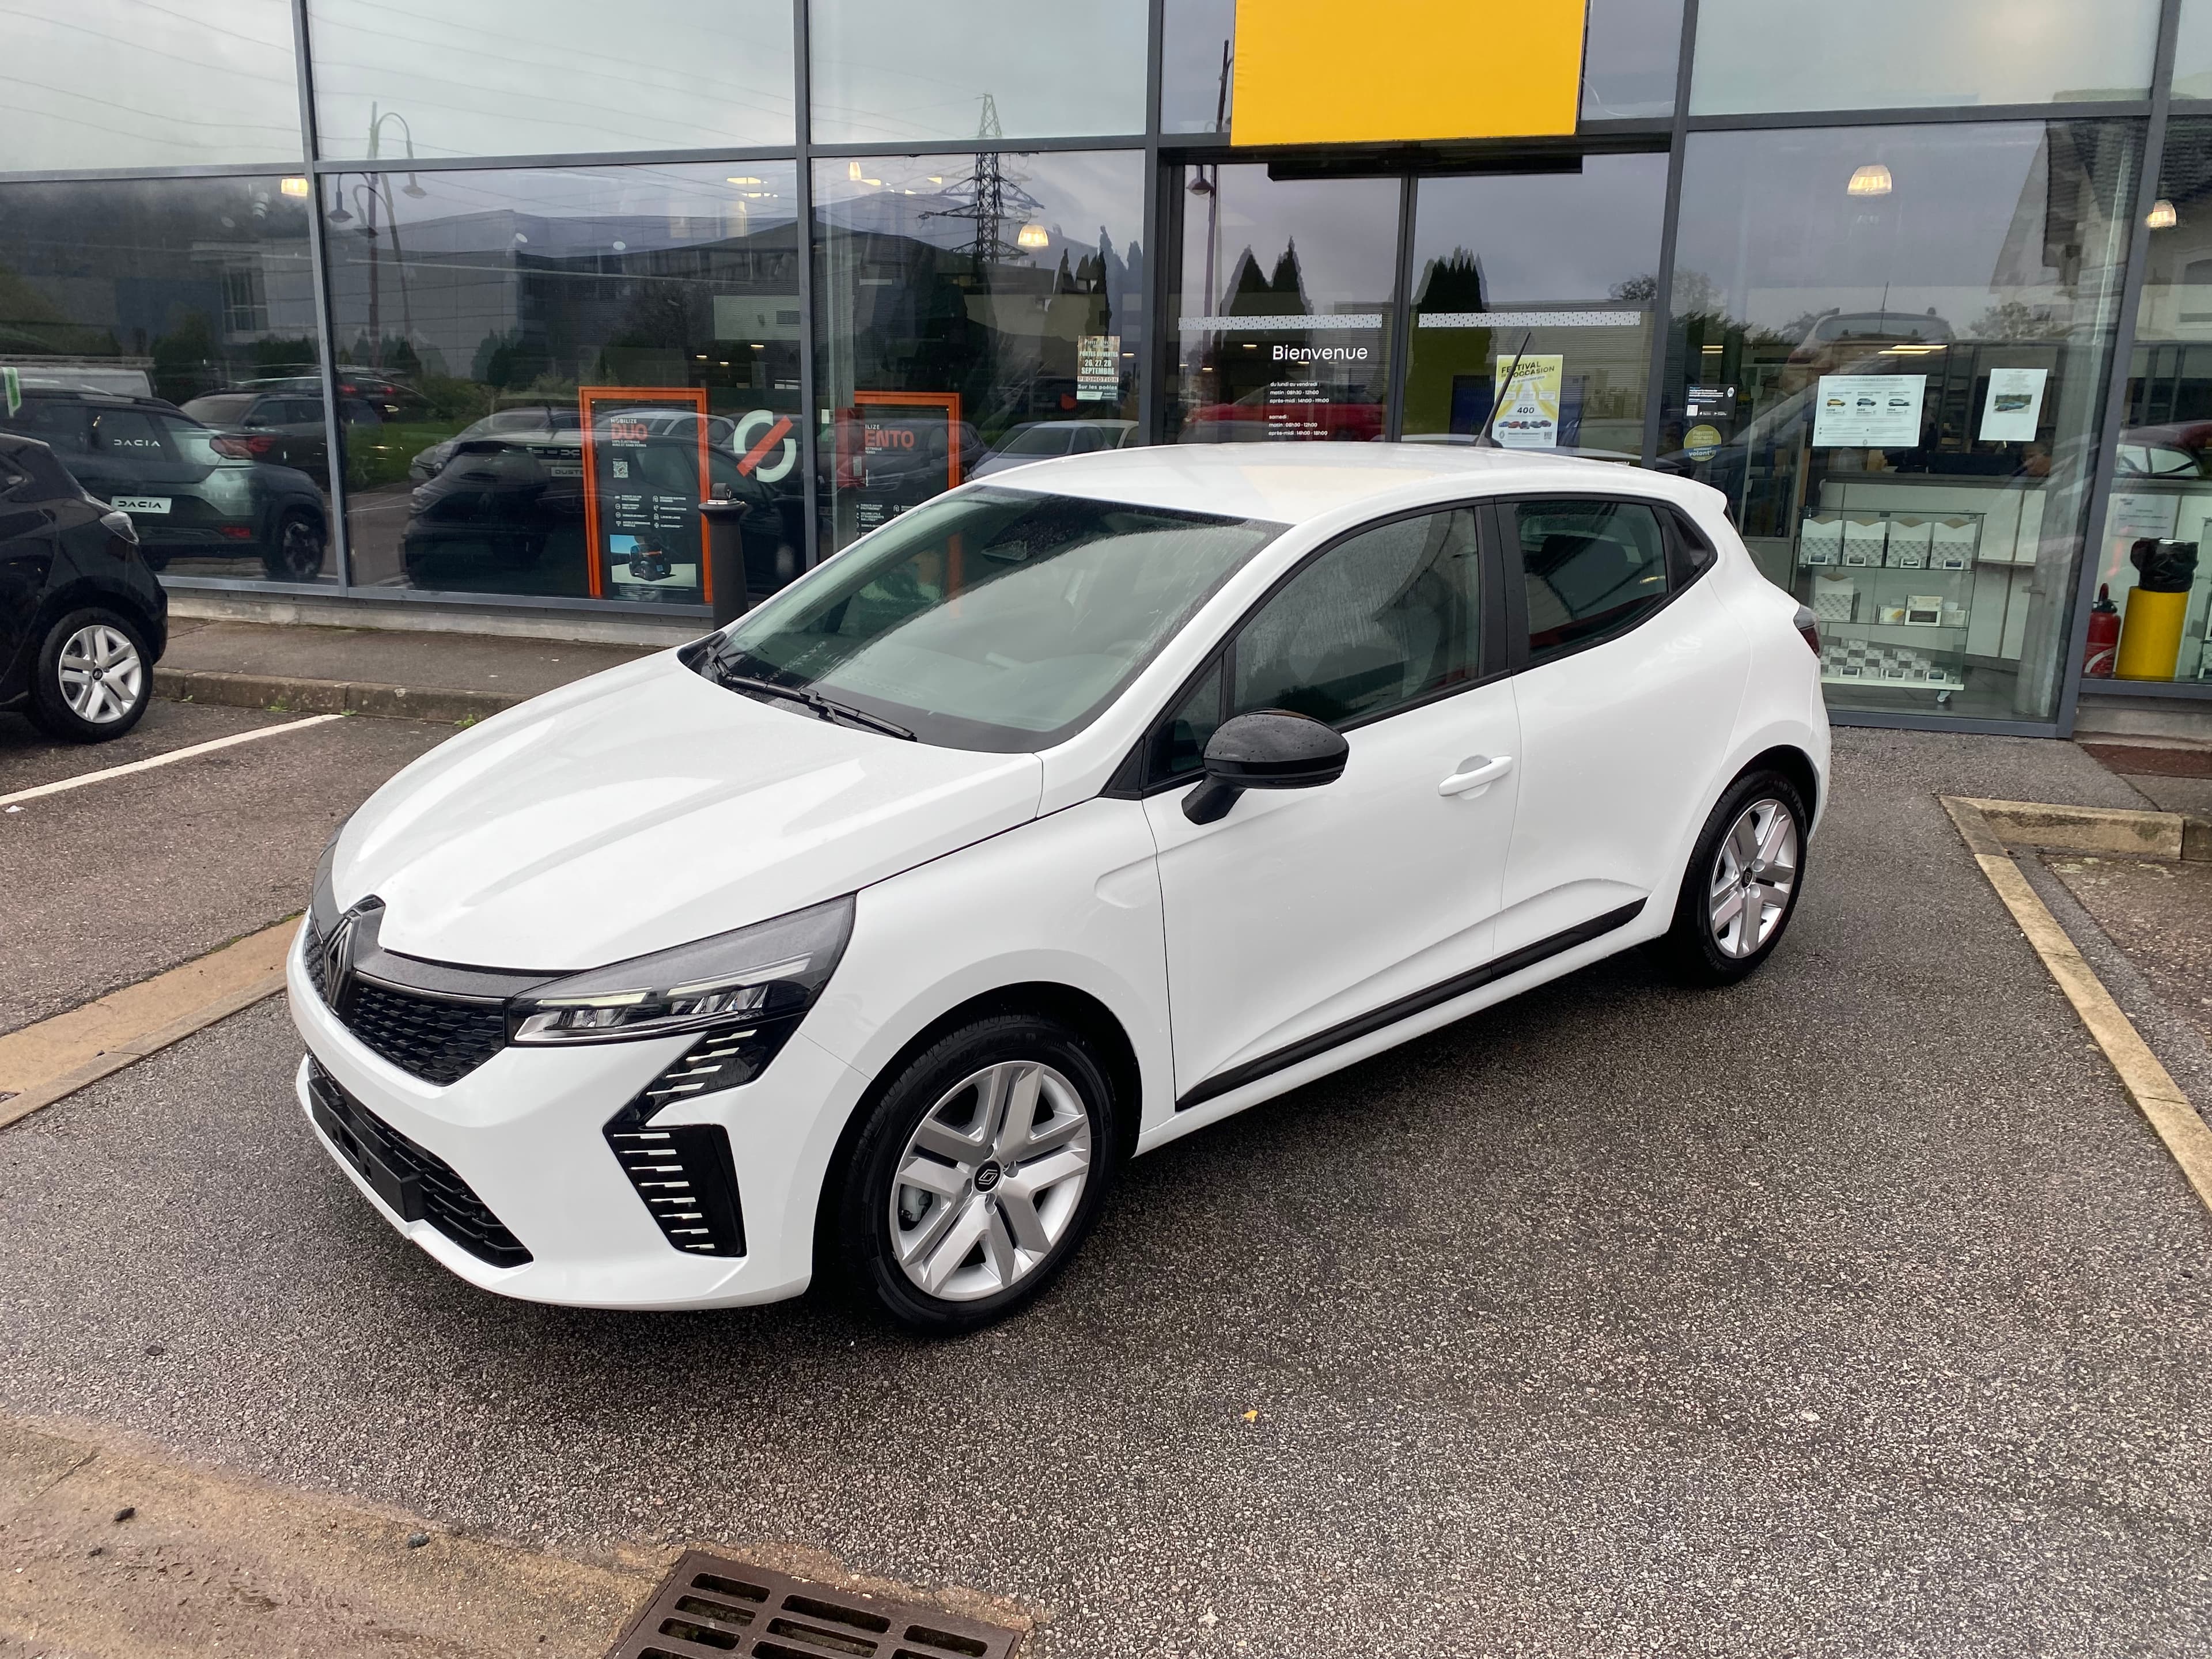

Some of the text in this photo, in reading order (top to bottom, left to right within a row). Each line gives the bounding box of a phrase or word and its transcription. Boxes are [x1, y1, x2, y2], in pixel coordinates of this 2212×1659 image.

[1272, 344, 1368, 359] Bienvenue
[1502, 361, 1541, 374] FETIVAL
[1513, 366, 1555, 377] OCCASION
[611, 423, 648, 440] DUO
[865, 429, 914, 448] ENTO
[118, 501, 162, 509] DACIA
